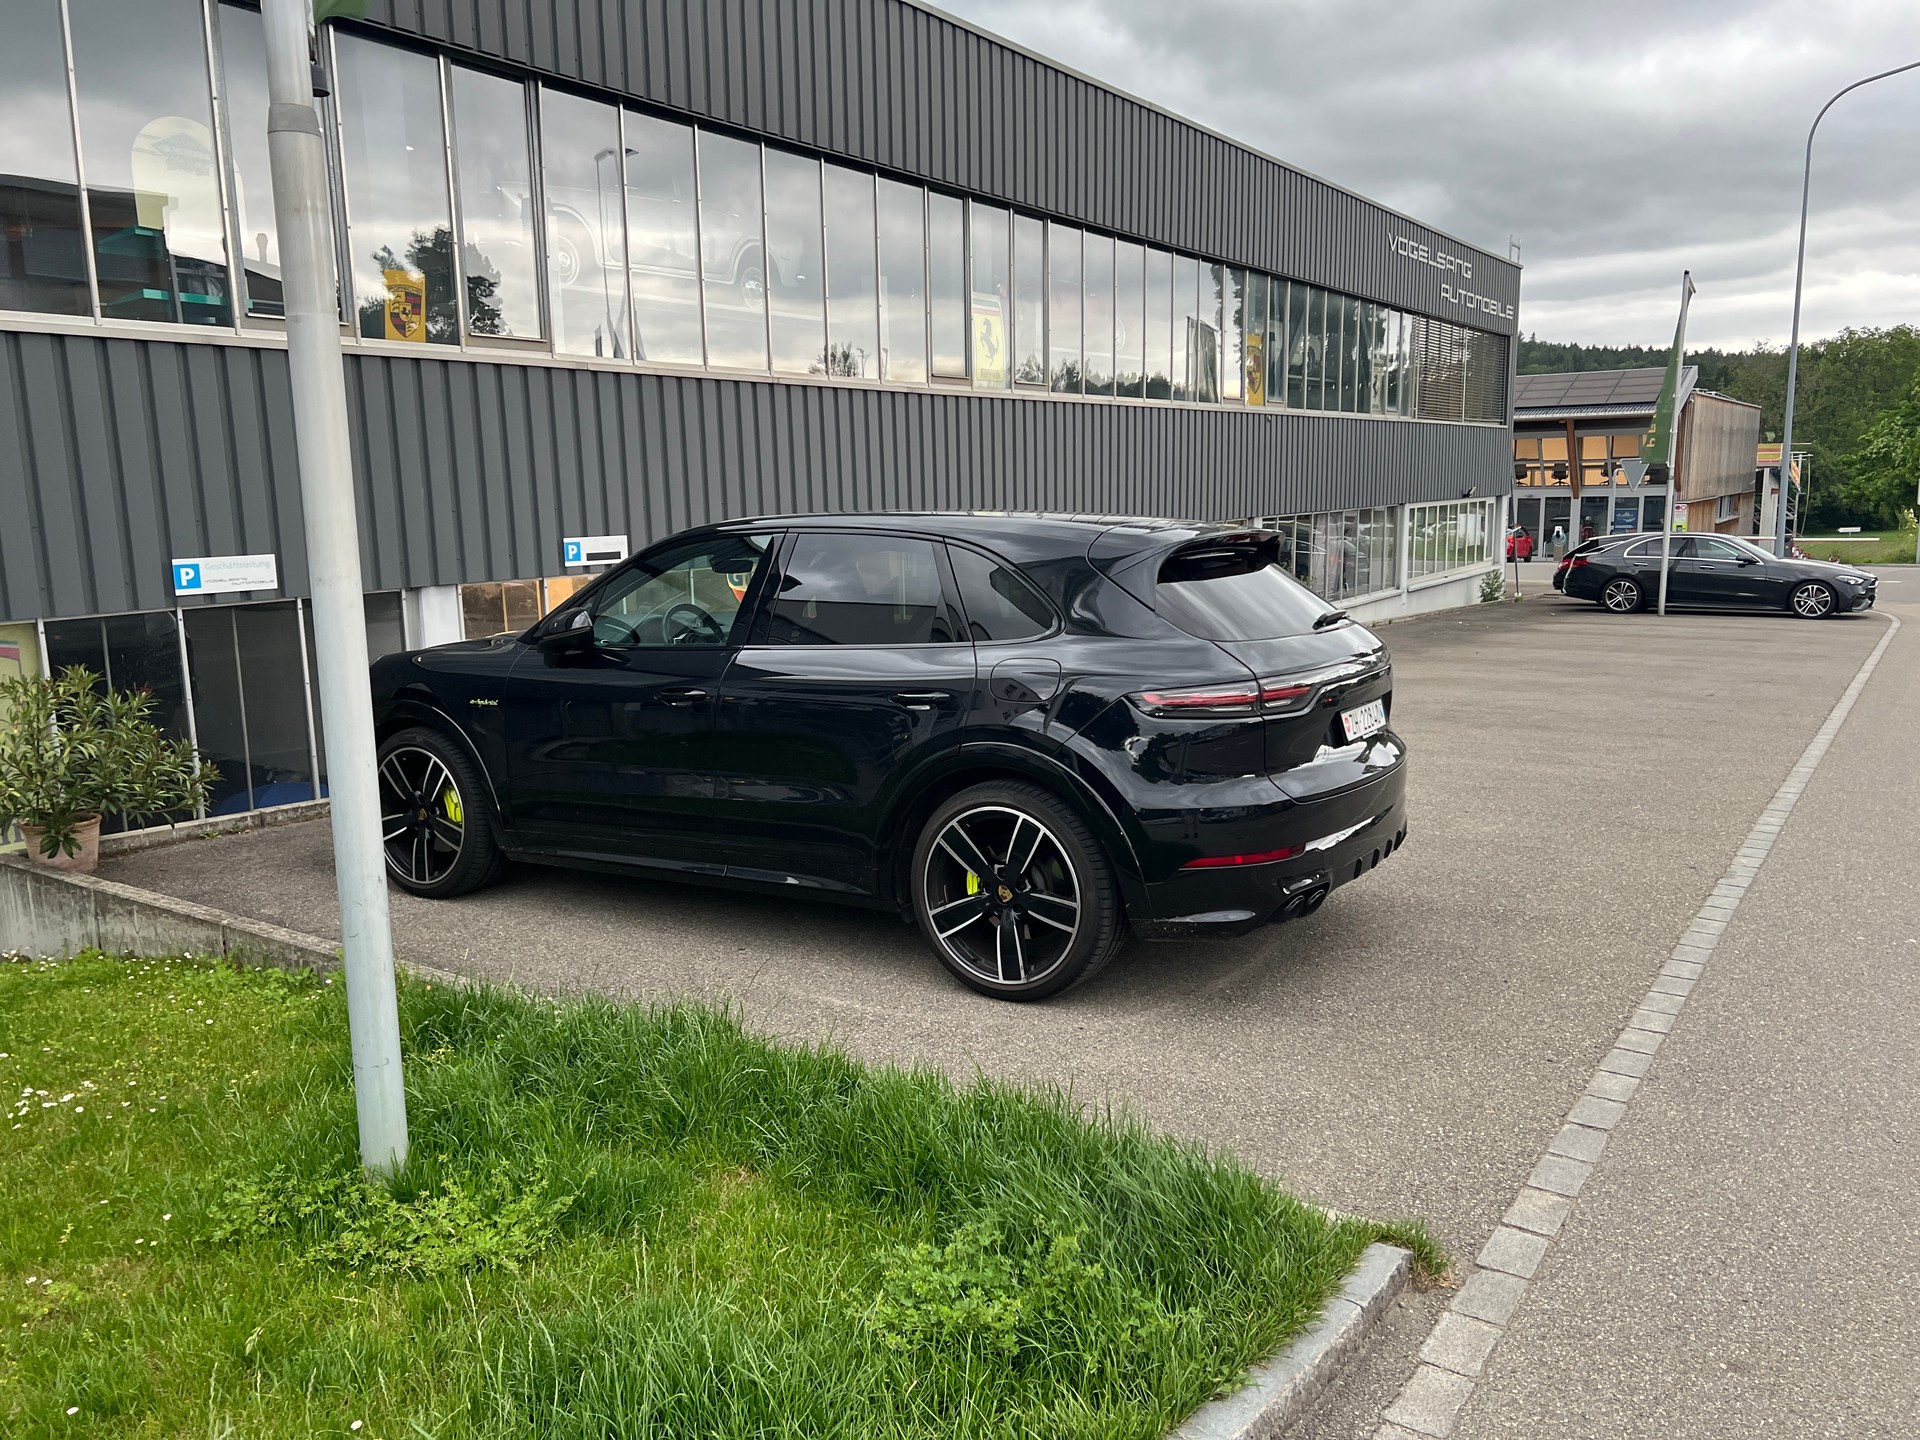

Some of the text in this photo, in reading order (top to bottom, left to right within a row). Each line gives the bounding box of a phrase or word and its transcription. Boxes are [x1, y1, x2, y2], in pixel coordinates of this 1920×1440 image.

[1388, 233, 1472, 278] VOGELSANG
[568, 544, 578, 560] P
[204, 561, 271, 570] Geschäftsleitung
[180, 567, 195, 587] P
